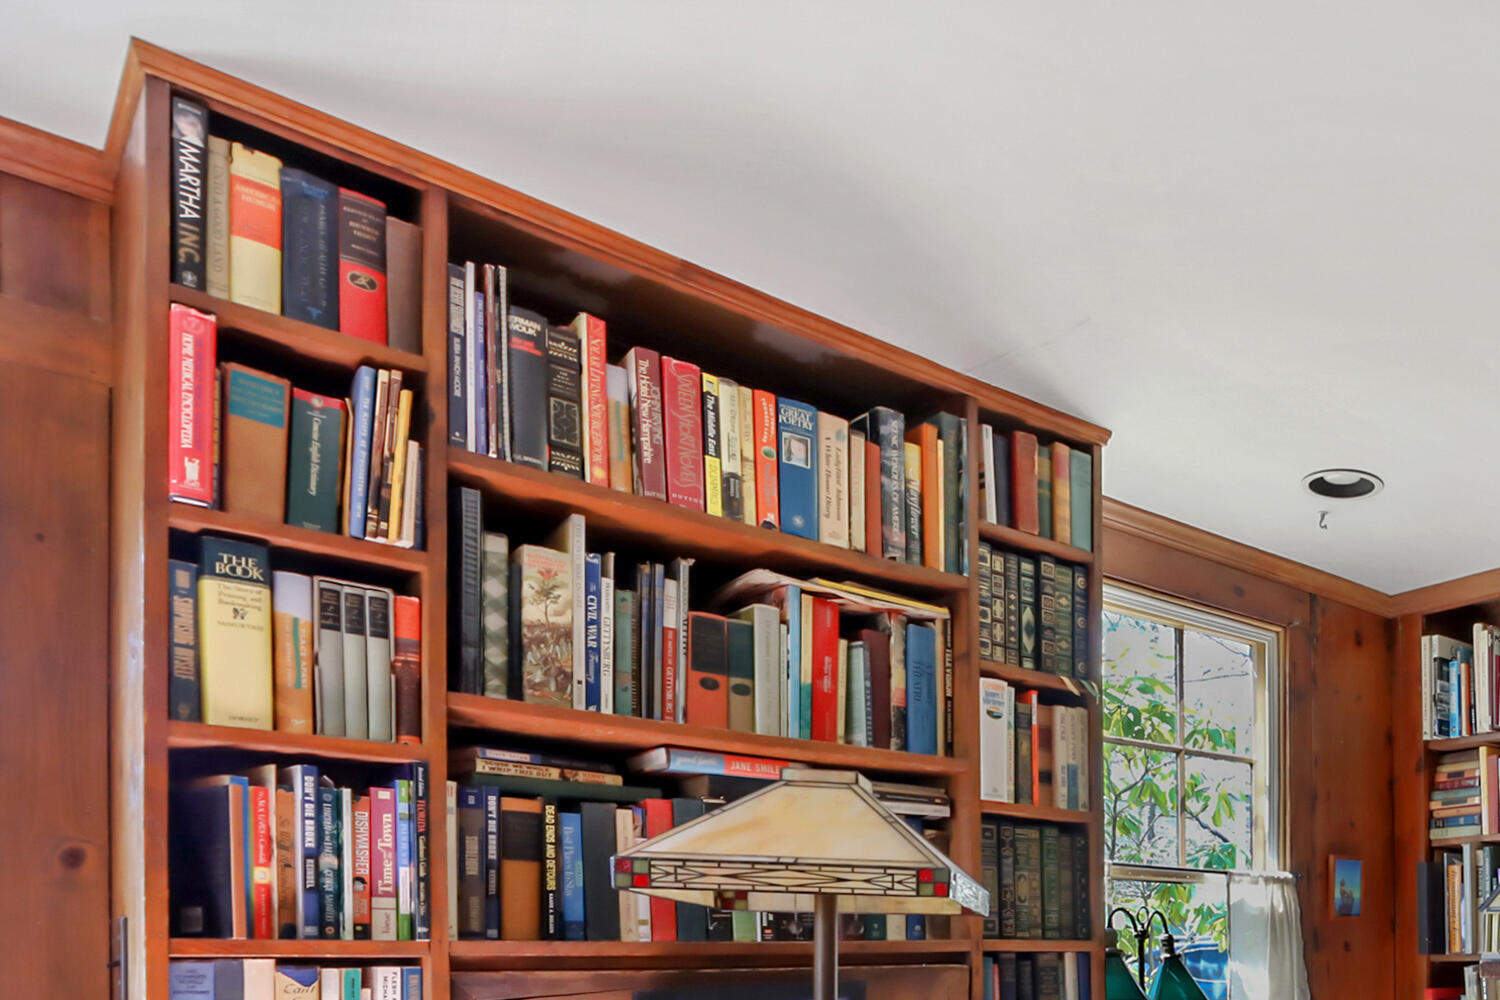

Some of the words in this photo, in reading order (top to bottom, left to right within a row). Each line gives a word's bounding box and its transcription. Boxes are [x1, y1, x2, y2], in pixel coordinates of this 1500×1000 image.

[177, 141, 202, 219] MARTHA
[706, 394, 716, 410] The
[707, 410, 717, 438] Middle
[707, 439, 717, 456] East
[218, 552, 259, 567] THE
[215, 562, 264, 581] BOOK
[586, 595, 598, 621] CIVIL
[587, 624, 599, 648] WAR
[666, 667, 674, 713] GETTYSBURG
[729, 760, 752, 772] JANE
[545, 805, 556, 823] DEAD
[355, 811, 368, 874] DISHWASHER
[545, 825, 556, 843] ENDS
[546, 844, 556, 858] AND
[546, 859, 557, 890] DETOURS
